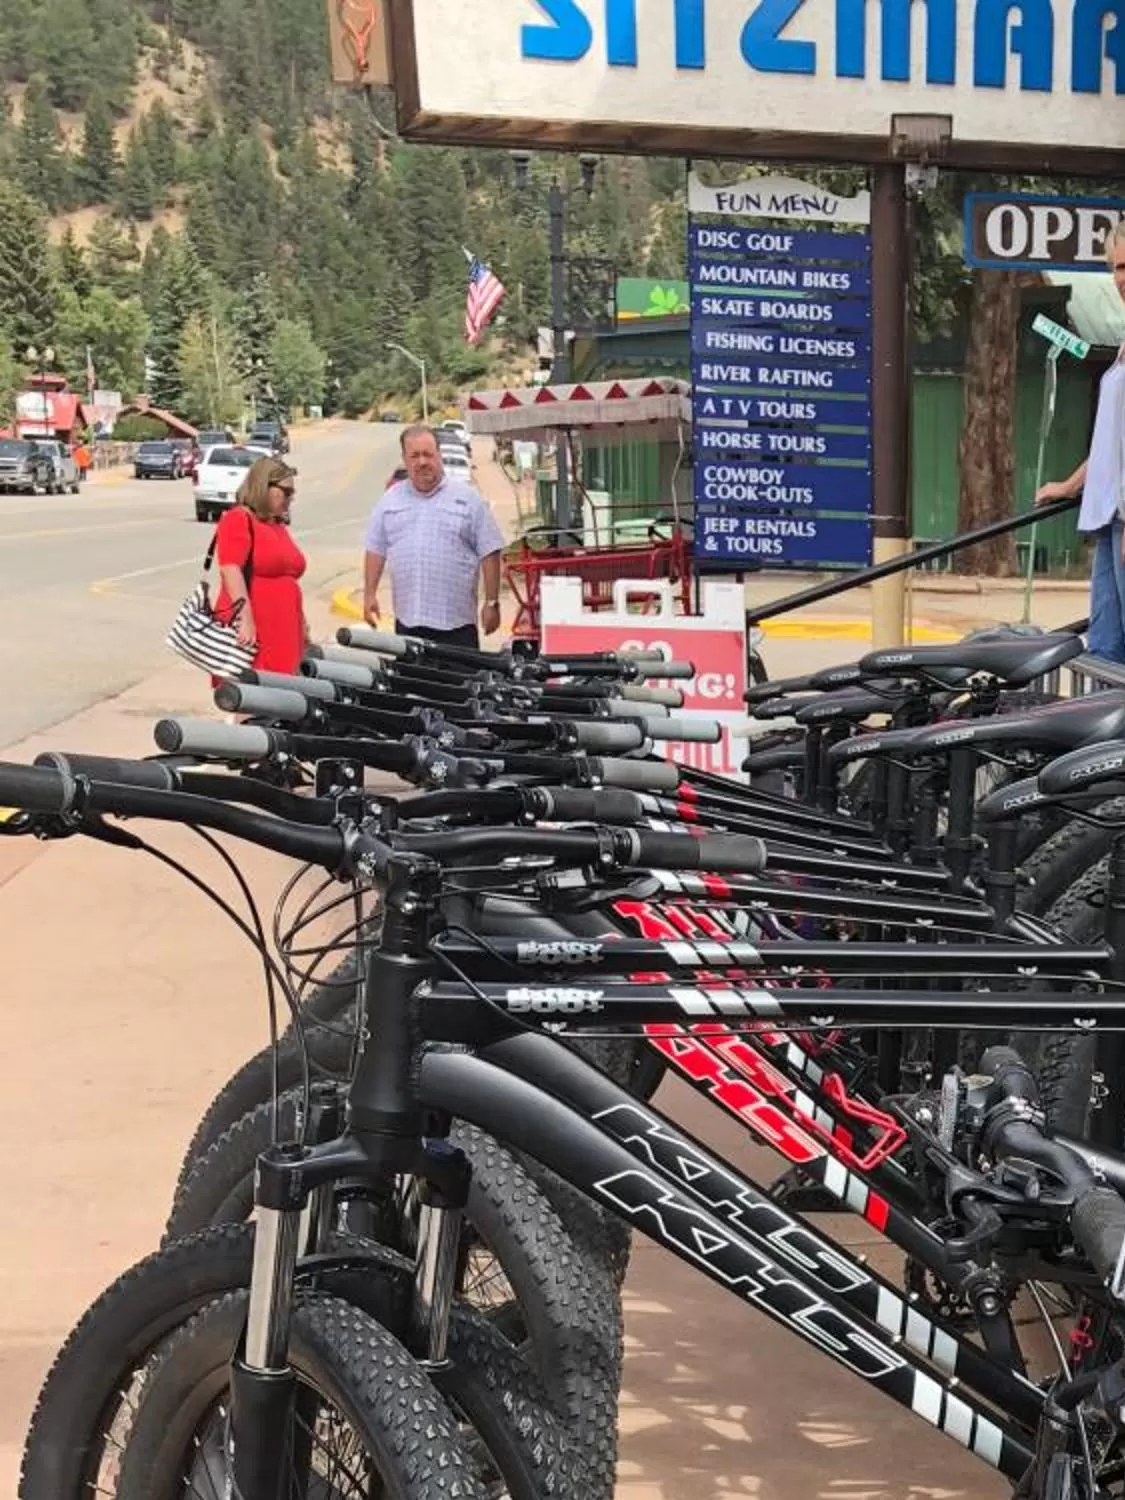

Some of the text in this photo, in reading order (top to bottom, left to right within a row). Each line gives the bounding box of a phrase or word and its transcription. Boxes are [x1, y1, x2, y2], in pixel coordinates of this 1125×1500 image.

[716, 191, 838, 216] FUN MENU
[697, 230, 794, 251] DISC GOLF
[699, 265, 850, 290] MOUNTAIN BIKES
[701, 297, 833, 322] SKATE BOARDS
[706, 331, 856, 357] FISHING LICENSES
[700, 363, 833, 388] RIVER RAFTING
[757, 401, 817, 419] TOURS
[702, 431, 827, 454] HORSE TOURS
[703, 465, 785, 485] COWBOY
[704, 484, 813, 504] COOK-OUTS
[704, 517, 816, 537] JEEP RENTALS
[704, 536, 783, 554] & TOURS
